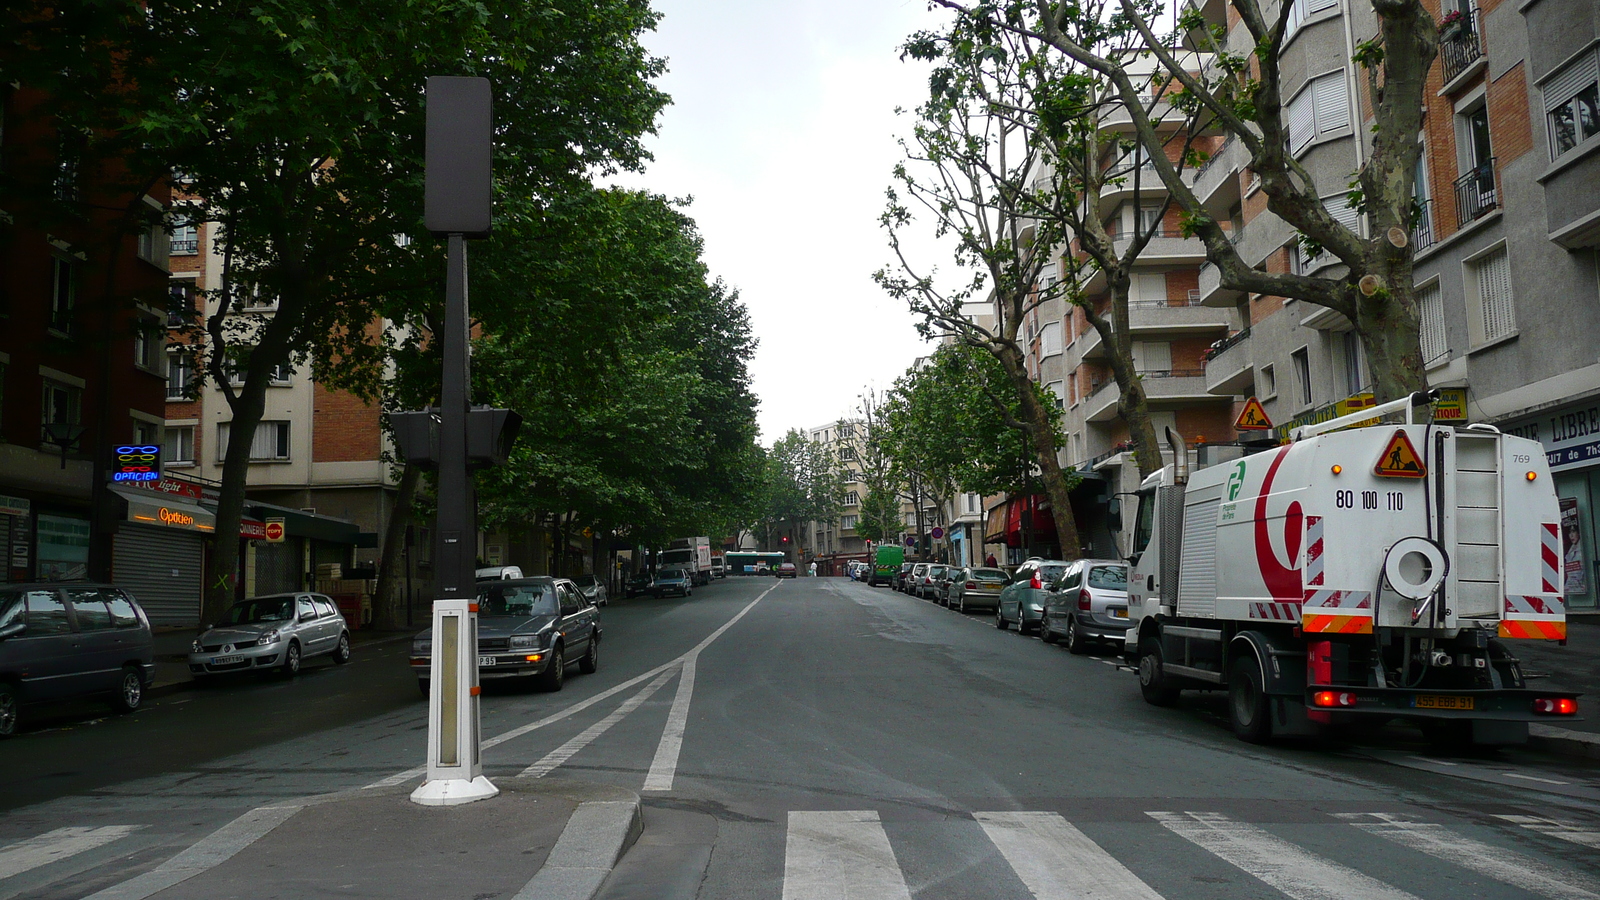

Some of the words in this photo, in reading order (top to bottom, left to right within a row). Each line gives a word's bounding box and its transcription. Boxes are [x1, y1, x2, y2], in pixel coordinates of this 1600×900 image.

[1550, 406, 1600, 443] LIBRE
[1512, 454, 1530, 464] 769
[1568, 450, 1579, 460] de
[114, 472, 159, 481] OPTICIEN
[1336, 489, 1354, 509] 80
[1361, 490, 1378, 510] 100
[1386, 491, 1403, 511] 110
[158, 507, 194, 525] Opticien
[485, 656, 495, 665] 95
[1416, 696, 1435, 707] 455
[1460, 698, 1472, 708] 91
